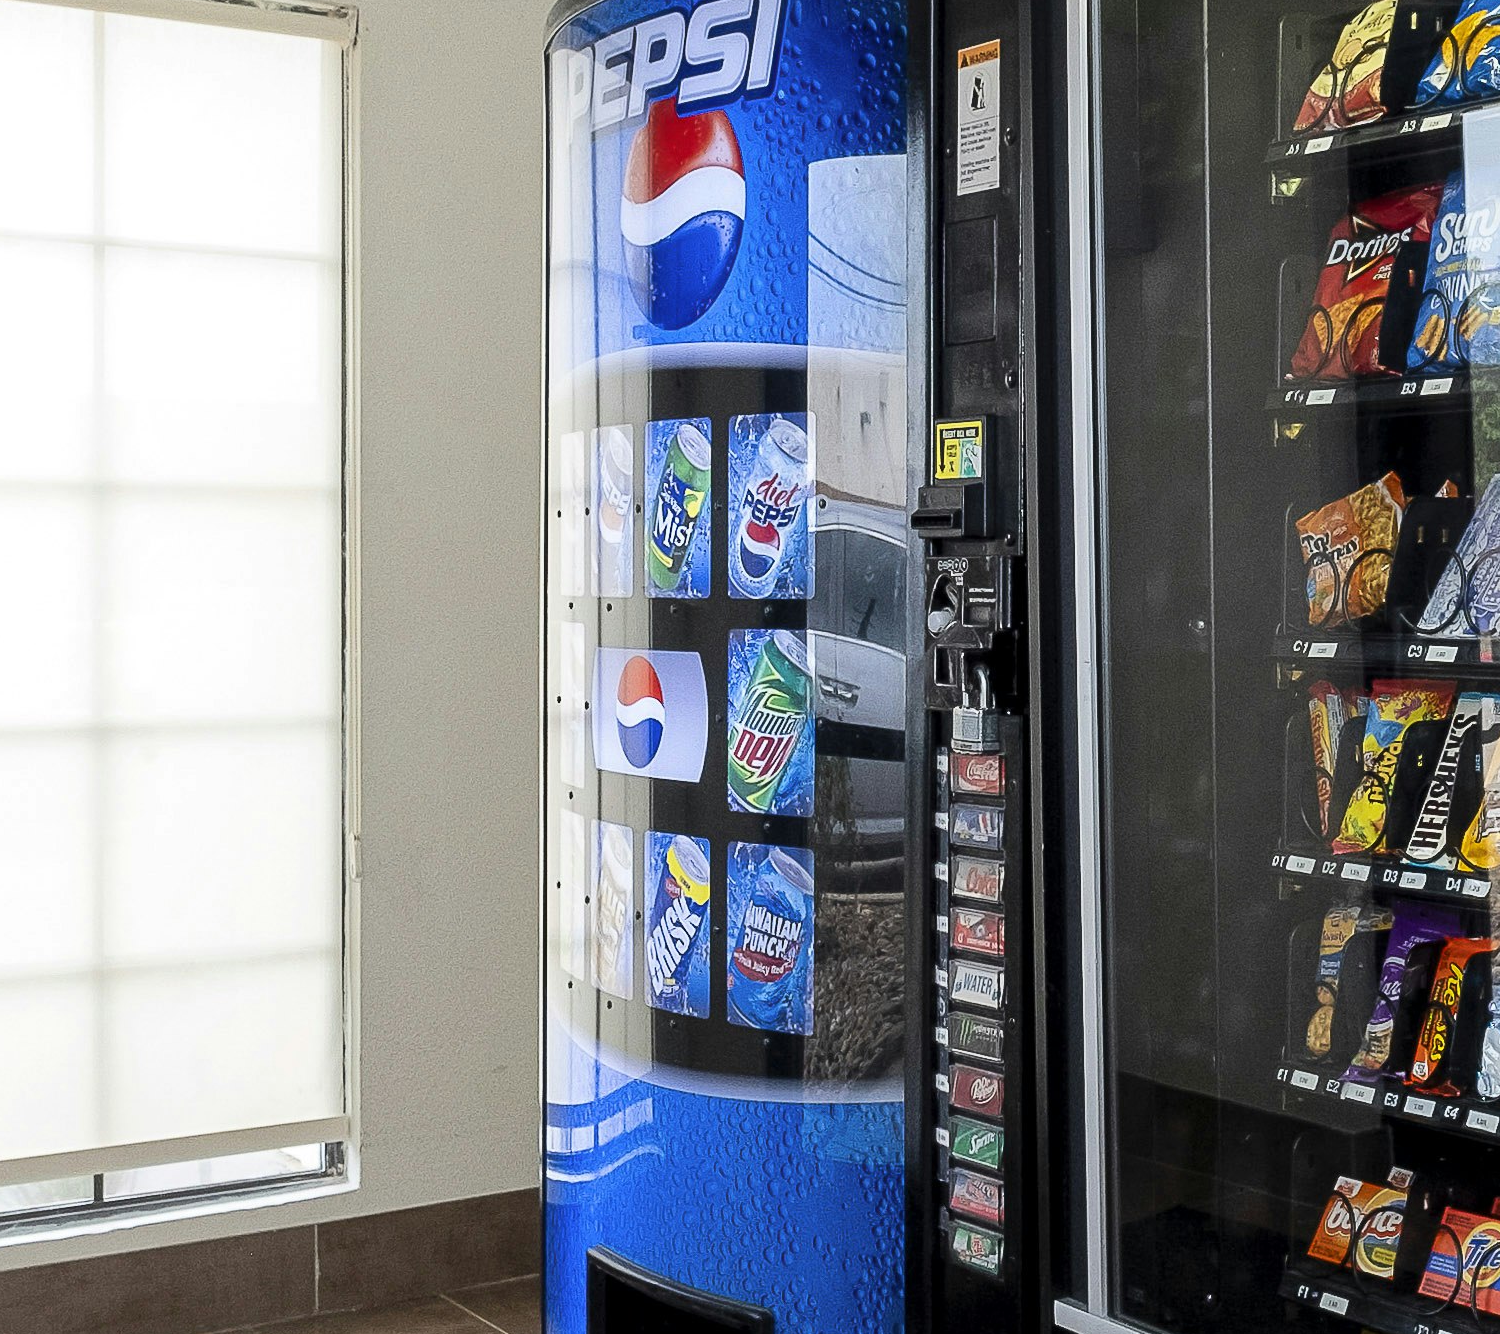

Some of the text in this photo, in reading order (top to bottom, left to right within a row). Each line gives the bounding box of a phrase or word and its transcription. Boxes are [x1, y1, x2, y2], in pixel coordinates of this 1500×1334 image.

[1400, 119, 1417, 134] A3
[1326, 227, 1412, 266] Doritos
[1452, 237, 1493, 256] CHIPS
[1400, 381, 1417, 395] B3
[756, 471, 802, 509] diet
[742, 489, 801, 528] PEPSI
[652, 494, 694, 548] Mist
[1292, 640, 1309, 655] C1
[1407, 644, 1423, 658] C3
[1272, 855, 1285, 868] D1
[1322, 860, 1336, 875] D2
[1383, 869, 1398, 883] D3
[1446, 876, 1461, 892] D4
[646, 894, 702, 997] BRISK
[742, 927, 791, 960] PUNCH
[751, 959, 770, 976] Juicy
[770, 961, 784, 975] Red
[963, 972, 993, 996] WATER
[1276, 1068, 1288, 1081] E1
[1384, 1092, 1399, 1107] E3
[969, 1131, 996, 1155] Sprite
[1297, 1284, 1309, 1299] F1
